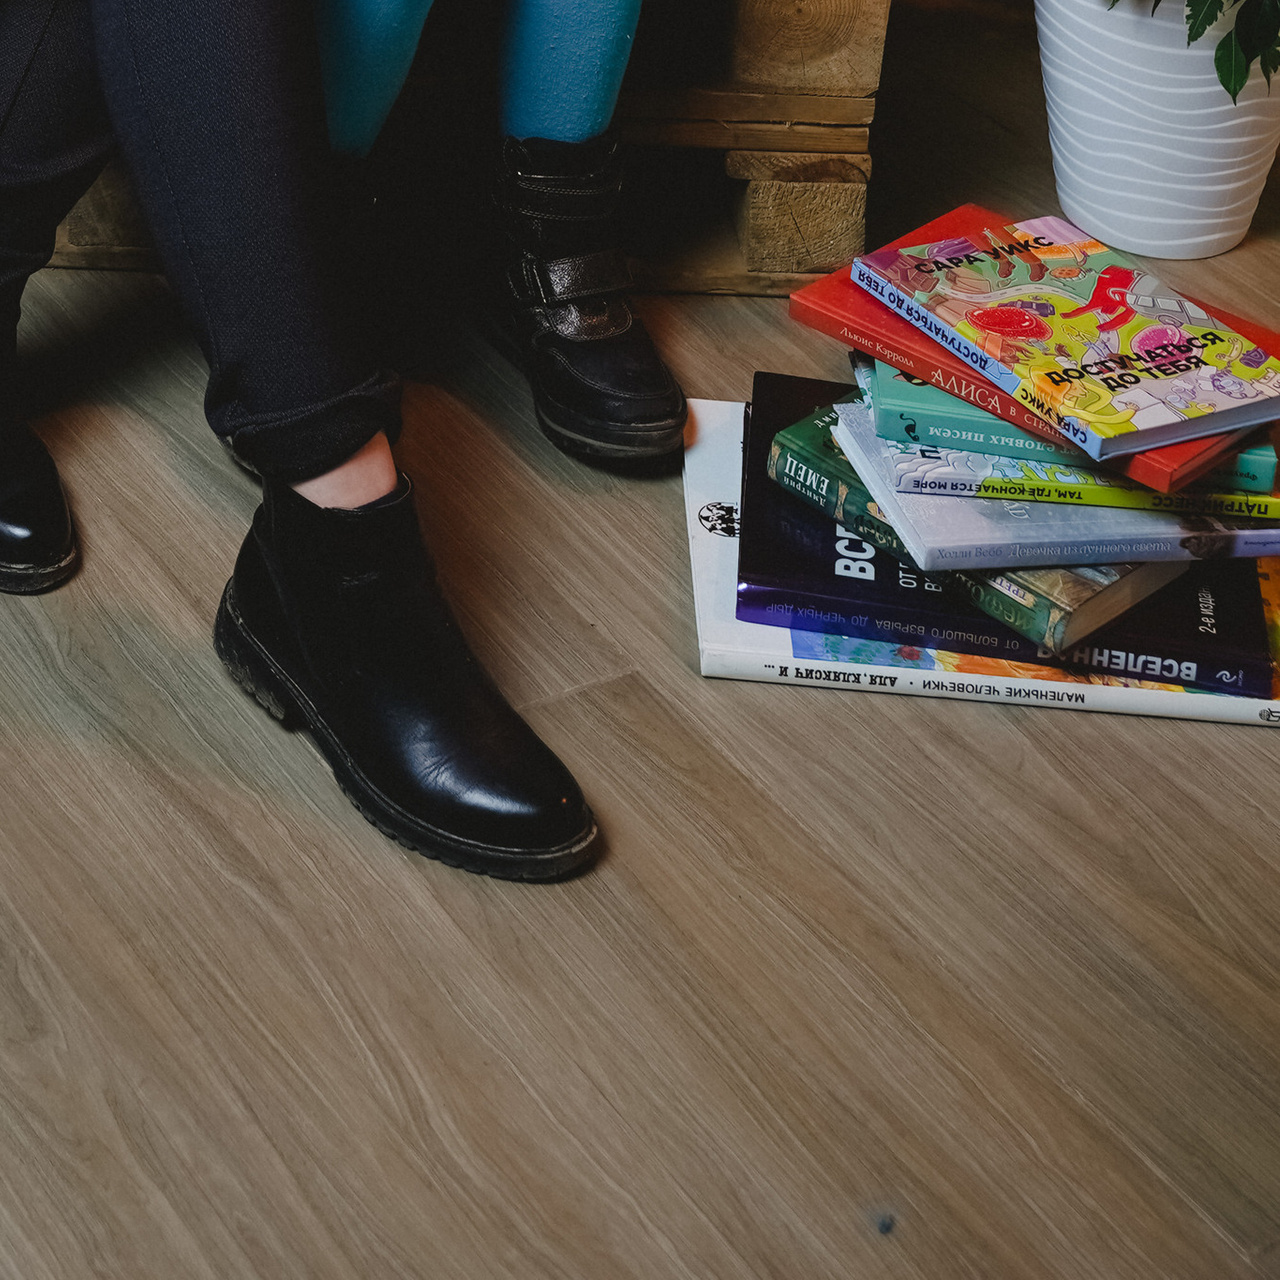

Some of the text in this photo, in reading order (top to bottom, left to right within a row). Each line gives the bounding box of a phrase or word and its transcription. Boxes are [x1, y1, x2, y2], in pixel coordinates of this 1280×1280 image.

[914, 237, 1055, 274] САРА УИКС
[857, 269, 989, 371] ДОСТУЧАТЬСЯ ДО ТЕБЯ
[840, 327, 874, 348] Льюис
[1045, 331, 1226, 386] ДОСТУЧАТЬСЯ
[1100, 354, 1211, 391] ДО ТЕБЯ
[931, 368, 1003, 414] АЛИСА
[1021, 387, 1088, 444] САРА УИКС
[929, 427, 985, 442] писем
[990, 434, 1056, 453] еловых
[784, 452, 830, 496] ЕМЕЦ
[913, 480, 1083, 500] ТАМ, ГДЕ КОНЧАЕТСЯ МОРЕ
[1195, 498, 1269, 516] ПАТРИК
[851, 615, 868, 628] ДО
[875, 619, 925, 636] ВЗРЫВА
[931, 627, 998, 647] БОЛЬШОГО
[1005, 640, 1019, 650] ОТ
[922, 679, 1000, 697] ЧЕЛОВЕЧКИ
[1005, 686, 1085, 703] МАЛЕНЬКИЕ
